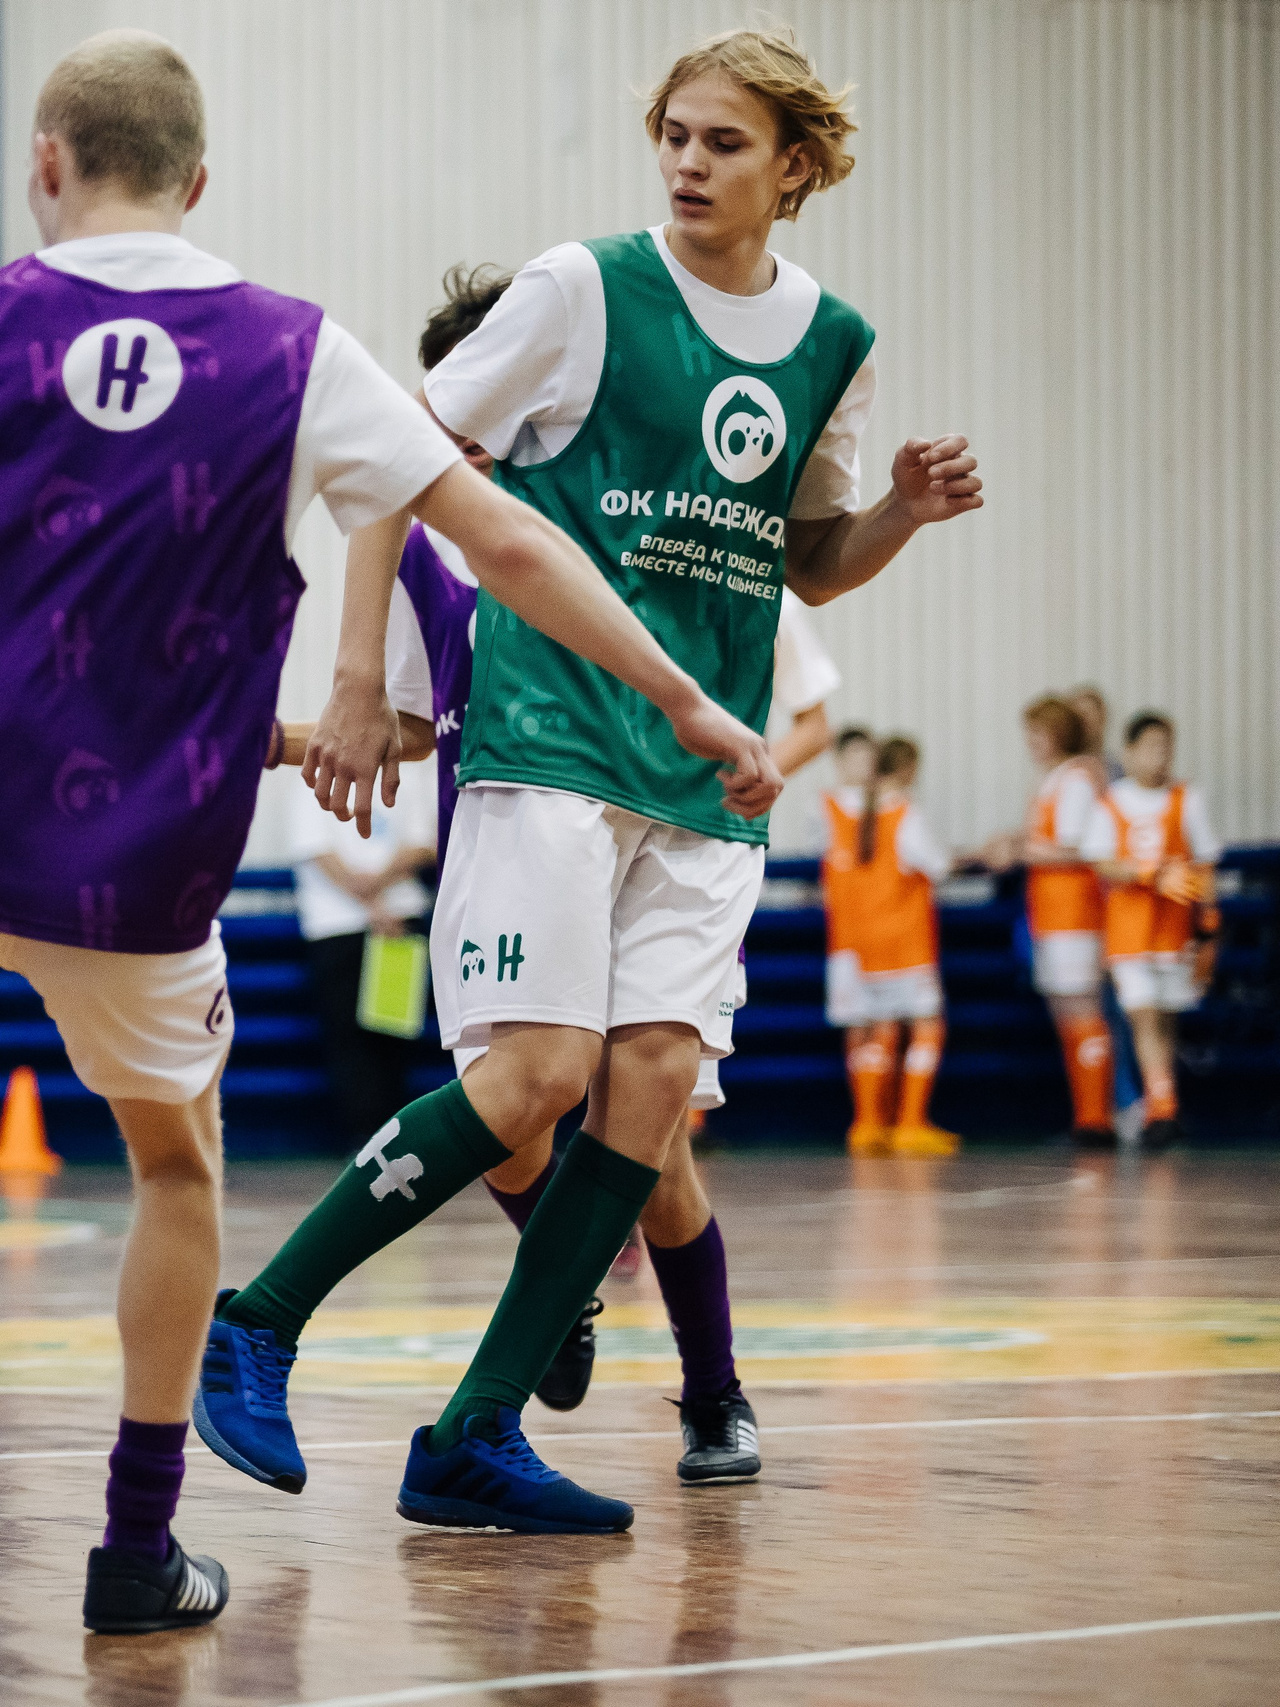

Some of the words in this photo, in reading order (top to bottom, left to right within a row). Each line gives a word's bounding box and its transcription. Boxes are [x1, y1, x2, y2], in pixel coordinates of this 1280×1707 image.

[600, 489, 655, 516] ФК
[665, 491, 785, 549] НАДЕЖД
[640, 534, 706, 561] ВПЕРЁД
[710, 548, 725, 564] К
[621, 552, 685, 576] ВМЕСТЕ
[690, 564, 724, 585] МЫ
